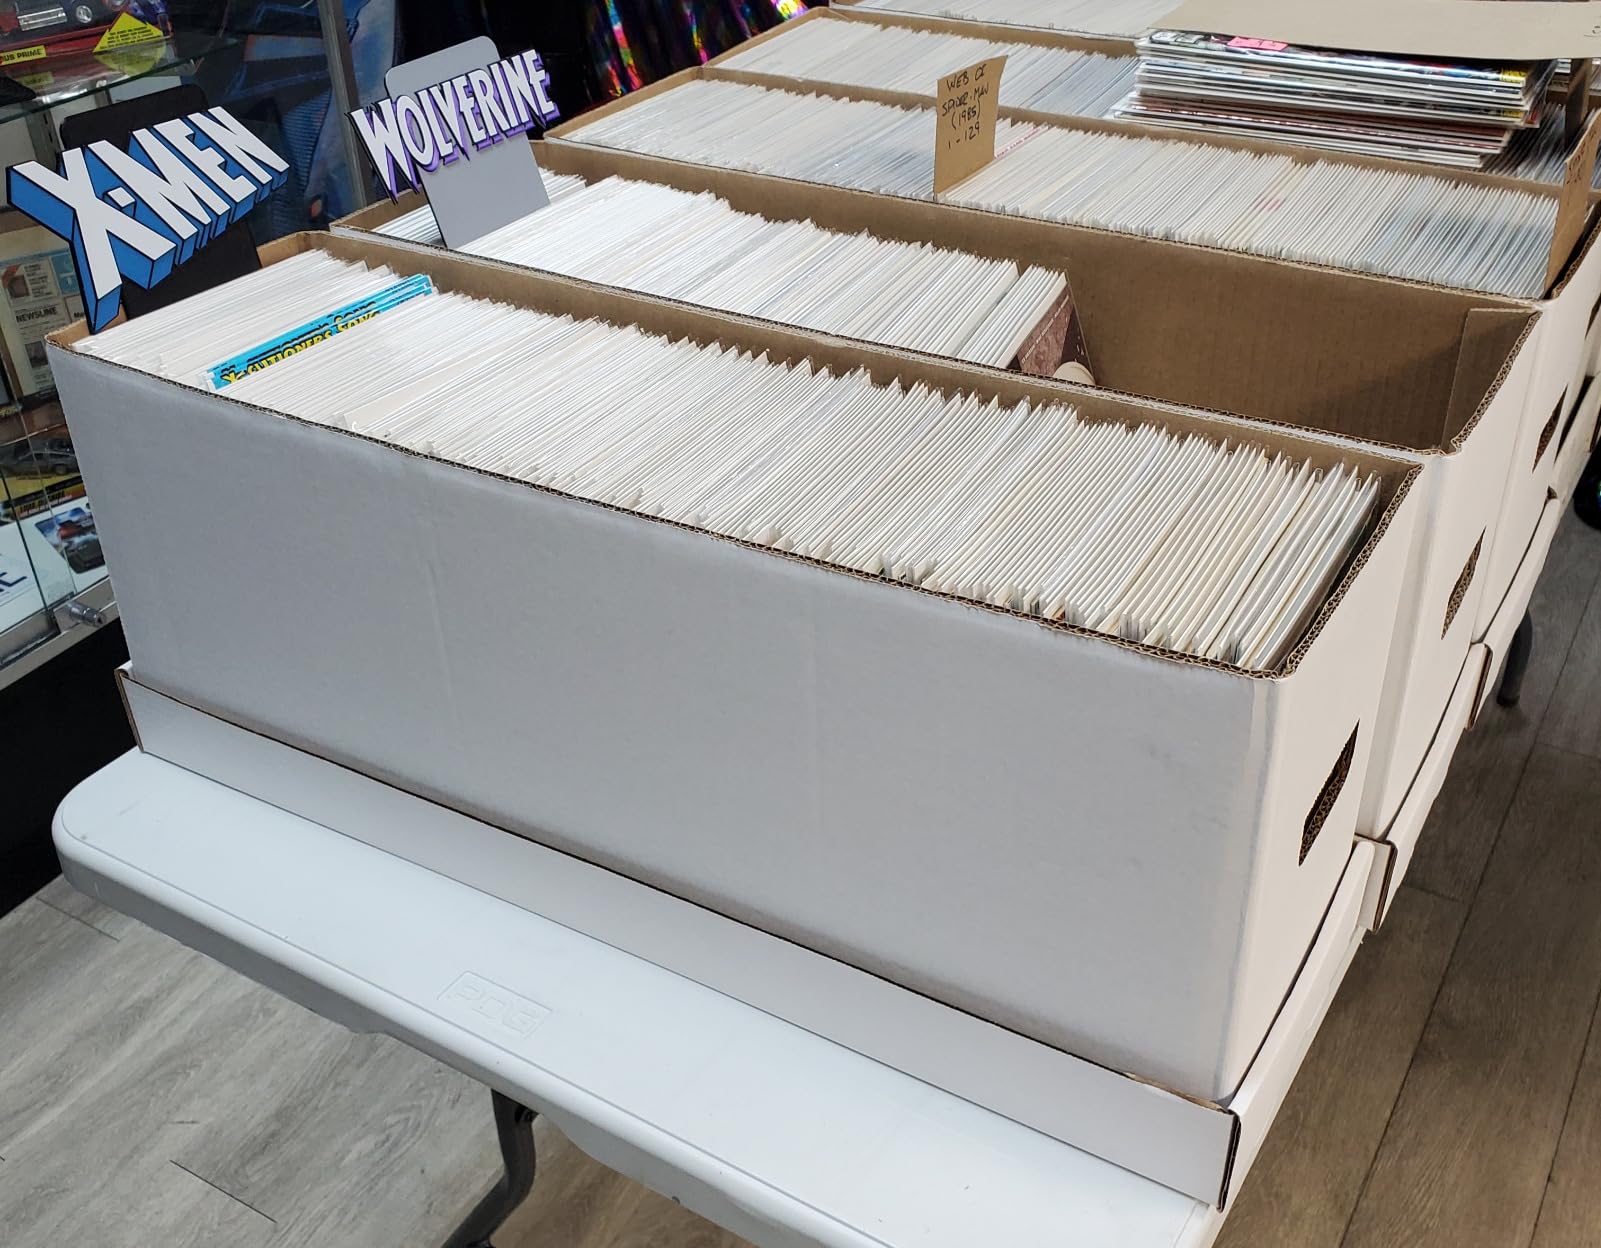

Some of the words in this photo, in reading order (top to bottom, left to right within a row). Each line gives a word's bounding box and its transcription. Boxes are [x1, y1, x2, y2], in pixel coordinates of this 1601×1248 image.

[16, 48, 42, 59] PRIME
[946, 71, 970, 92] WEB
[349, 49, 560, 203] WOLVERINE
[951, 99, 981, 131] (1985)
[8, 105, 291, 333] X-MEN
[15, 306, 57, 323] NEWSLINE
